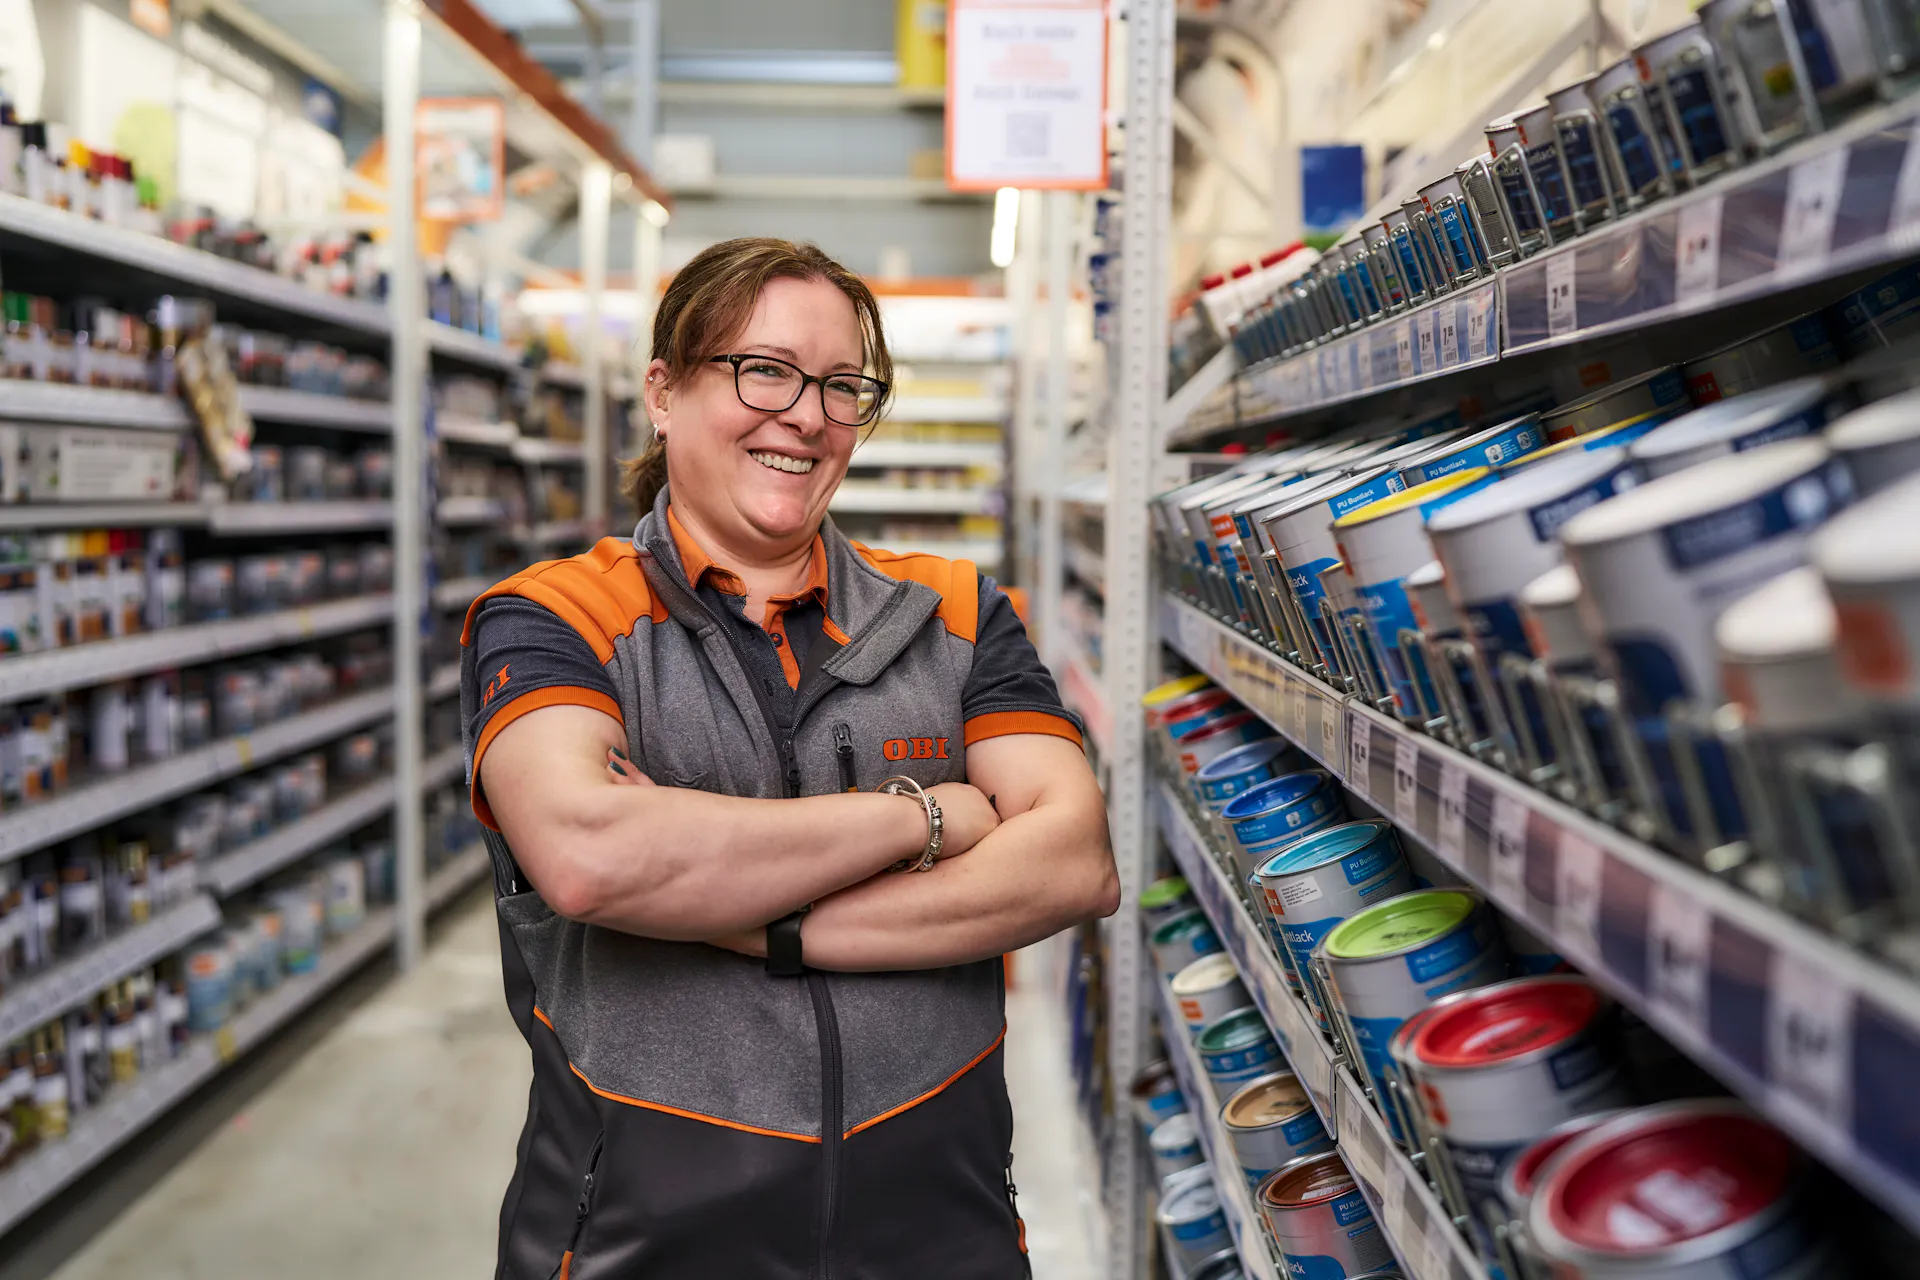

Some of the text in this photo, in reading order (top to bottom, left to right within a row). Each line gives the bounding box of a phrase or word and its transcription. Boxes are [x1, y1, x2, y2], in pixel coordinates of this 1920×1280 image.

[1347, 488, 1375, 505] Buntlack
[882, 737, 949, 761] OBI
[1349, 861, 1360, 871] PU
